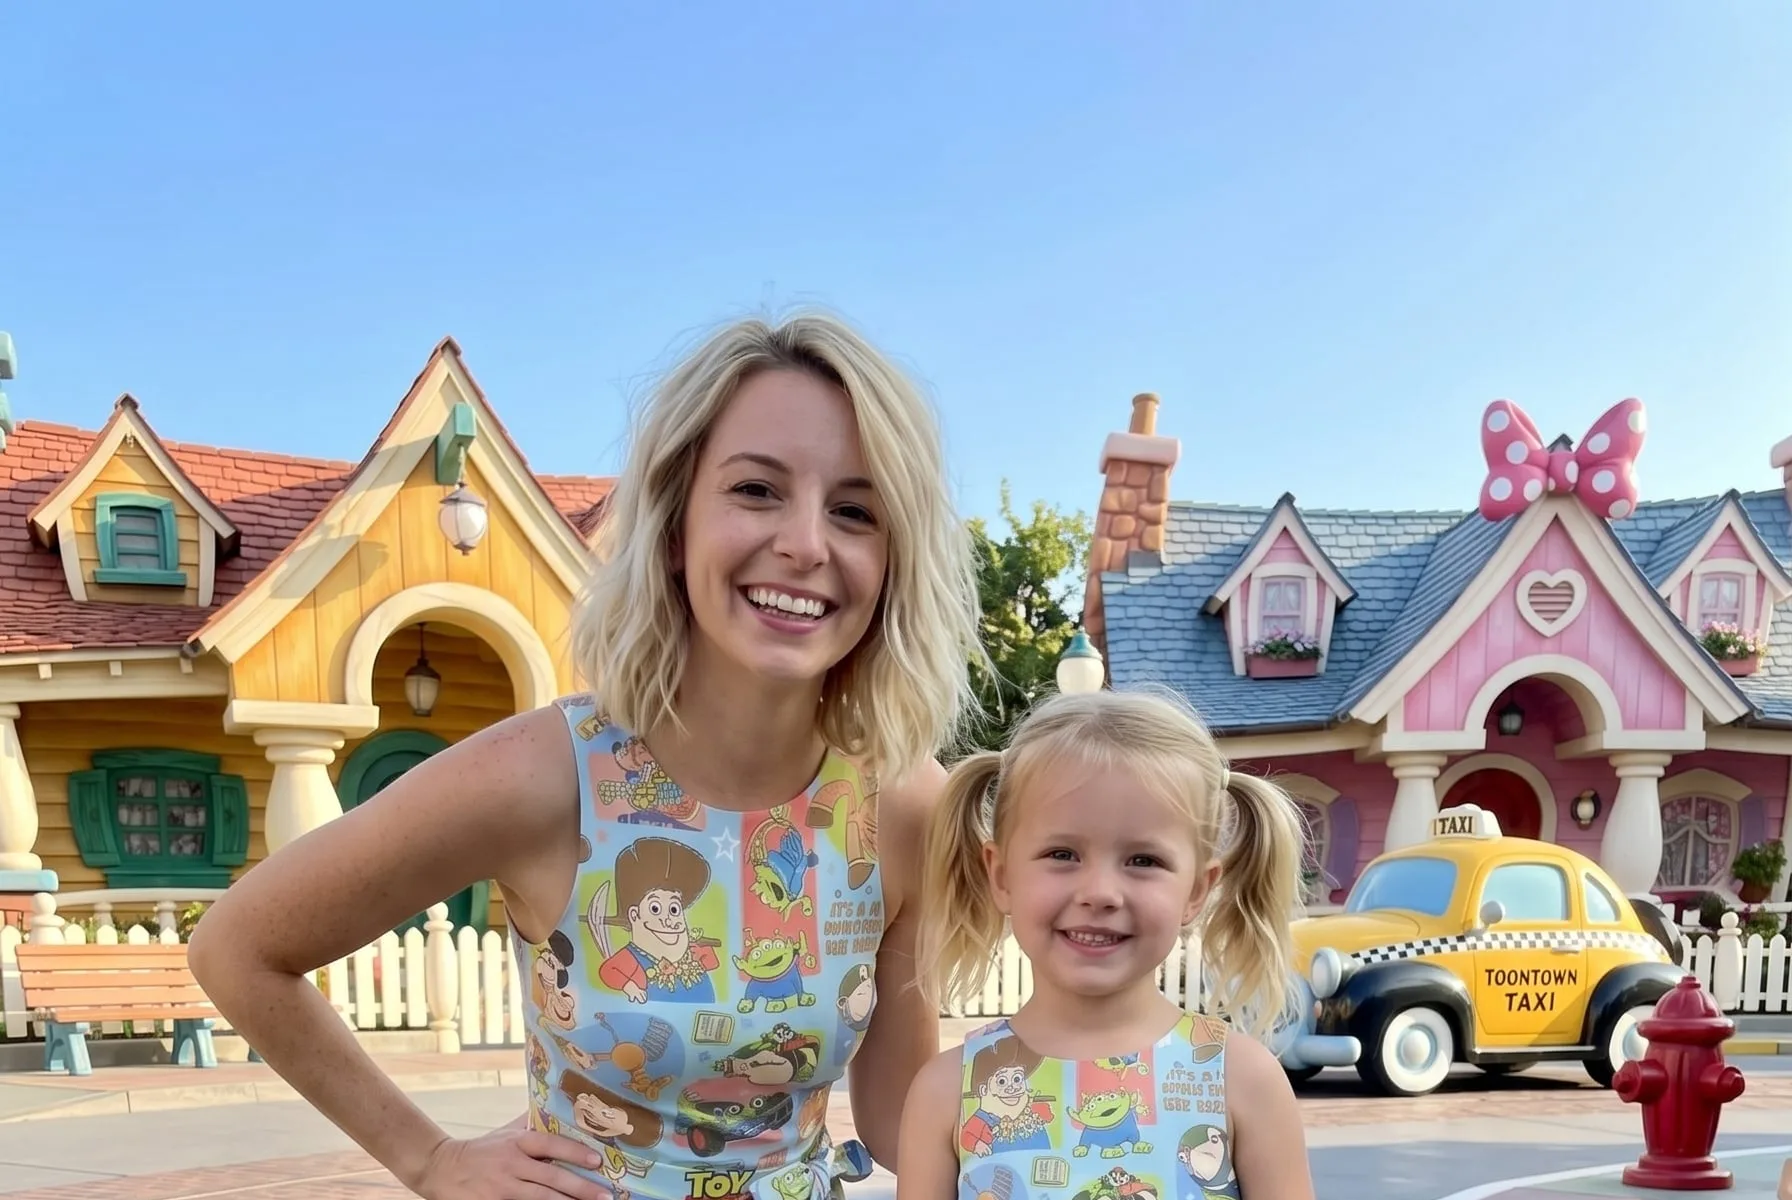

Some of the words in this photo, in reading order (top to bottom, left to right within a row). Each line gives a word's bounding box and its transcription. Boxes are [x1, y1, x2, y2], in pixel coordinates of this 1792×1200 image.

[1438, 816, 1473, 835] TAXI
[1484, 968, 1578, 986] TOONTOWN
[1504, 991, 1555, 1012] TAXI
[684, 1168, 756, 1200] TOY
